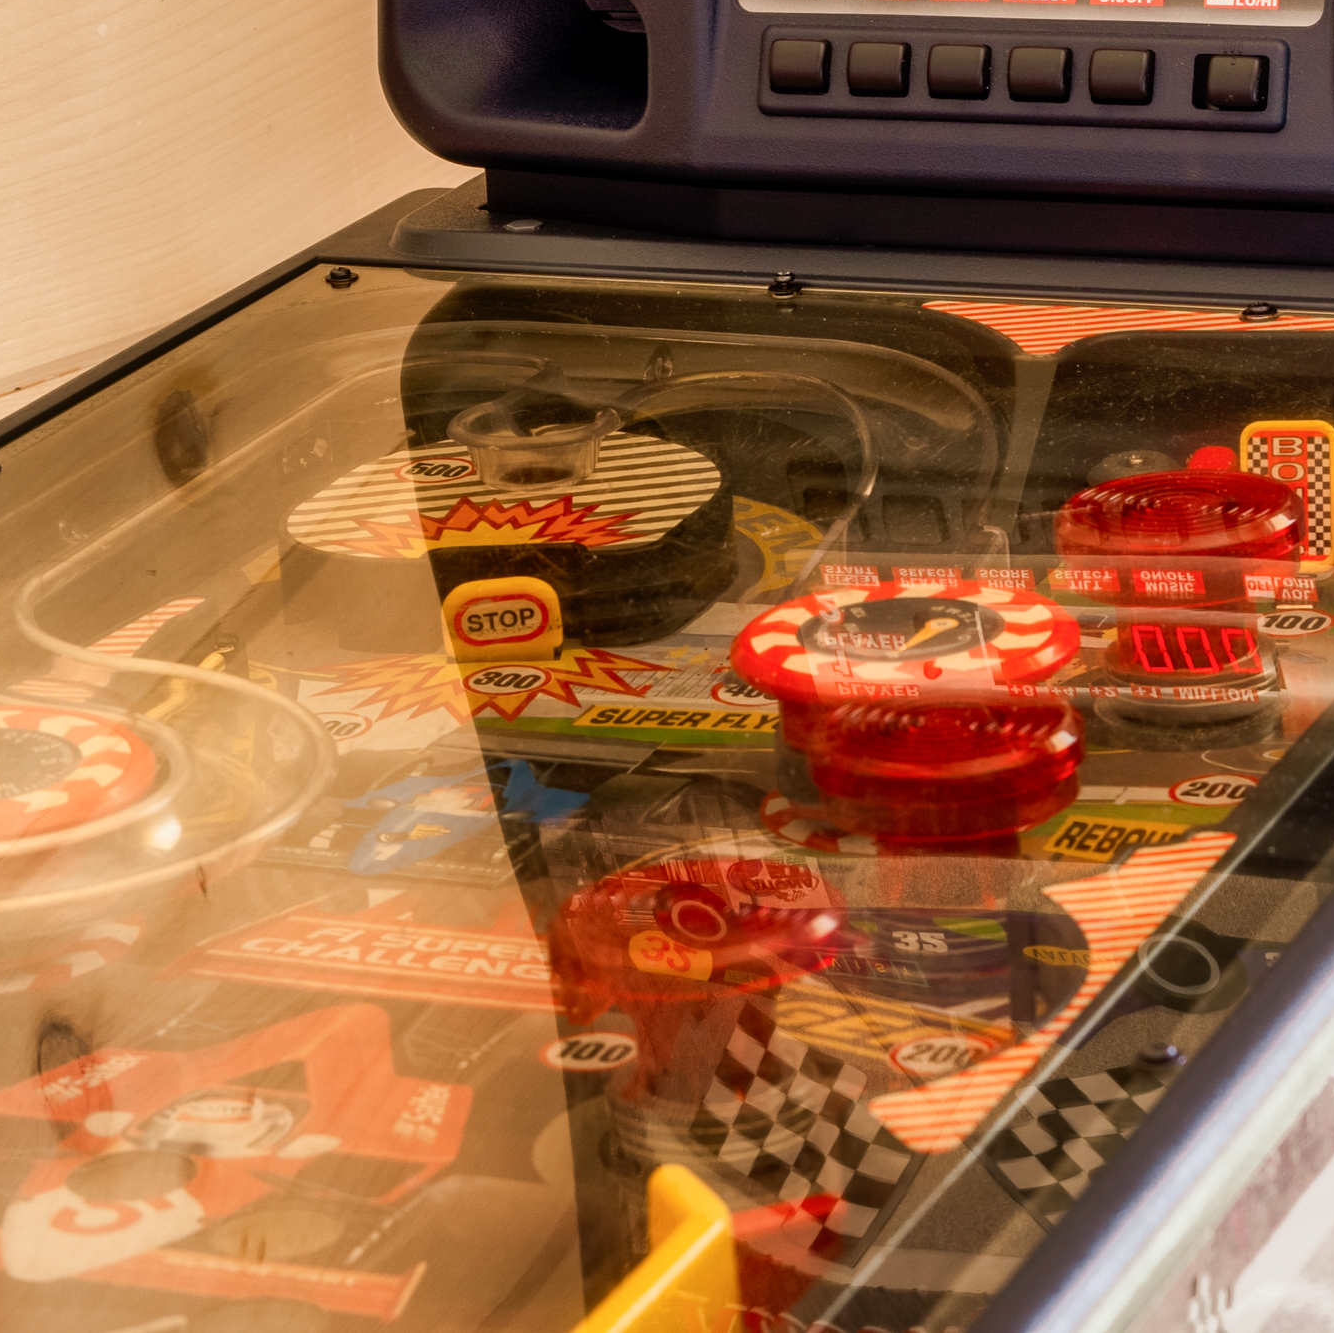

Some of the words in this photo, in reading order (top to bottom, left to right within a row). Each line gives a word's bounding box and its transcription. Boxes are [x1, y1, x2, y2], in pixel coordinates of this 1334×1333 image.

[406, 462, 469, 477] 500
[467, 608, 535, 632] STOP
[1263, 615, 1327, 631] 100
[473, 671, 541, 689] 300
[589, 708, 711, 727] SUPER
[371, 932, 551, 963] SUPER
[241, 937, 551, 981] CHALLENG
[560, 1039, 632, 1063] 100
